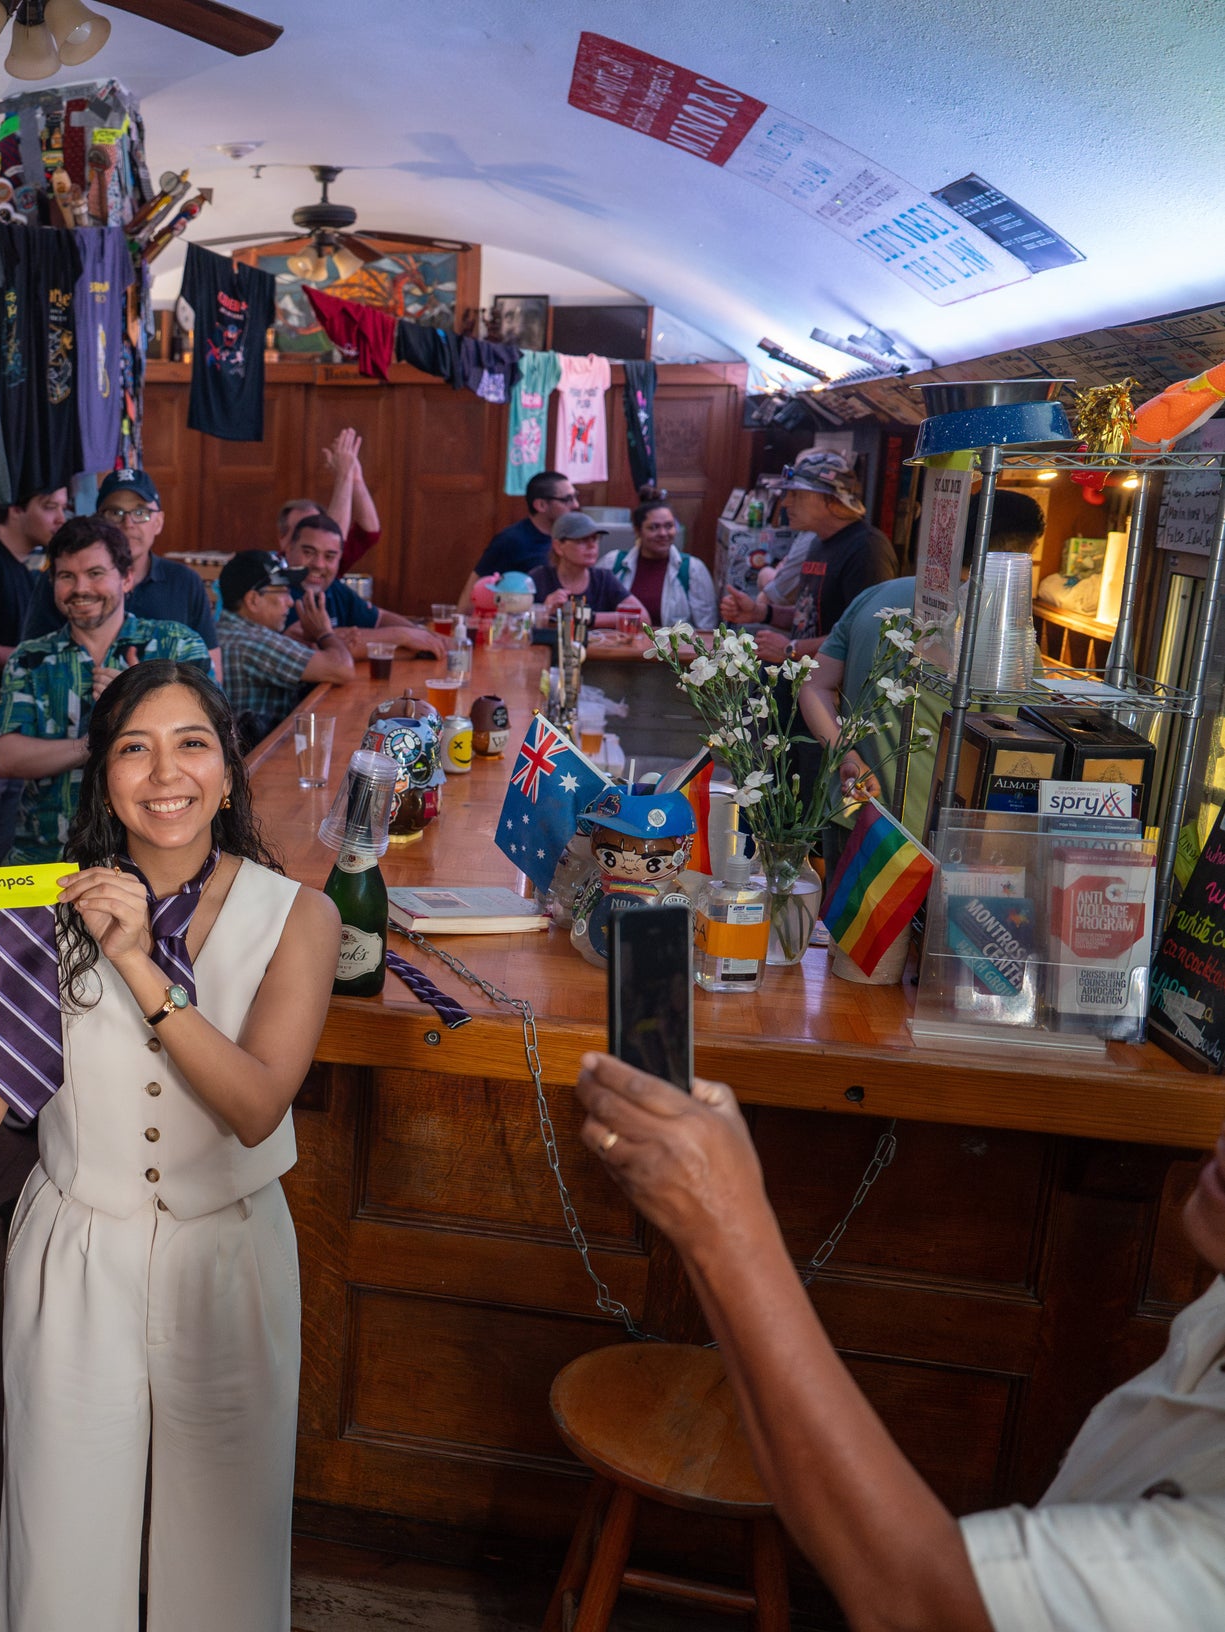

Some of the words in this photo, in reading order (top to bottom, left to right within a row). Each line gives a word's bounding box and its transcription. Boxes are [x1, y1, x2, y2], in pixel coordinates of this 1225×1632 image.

[666, 78, 744, 158] MINORS
[857, 223, 917, 263] LET'S
[892, 202, 960, 245] OBEY
[902, 255, 956, 291] THE
[933, 236, 995, 279] LAW
[934, 478, 948, 493] SCAN
[949, 479, 962, 494] ME
[1049, 794, 1098, 815] spry
[1077, 891, 1103, 905] ANTI
[1076, 903, 1129, 919] VIOLENCE
[1075, 916, 1134, 932] PROGRAM
[1177, 910, 1215, 943] white
[339, 944, 370, 962] ok's
[1080, 969, 1106, 979] CRISIS
[1107, 971, 1126, 979] HELP
[1079, 978, 1126, 988] COUNSELING
[1080, 994, 1123, 1005] EDUCATION
[1081, 986, 1123, 997] ADVOCACY
